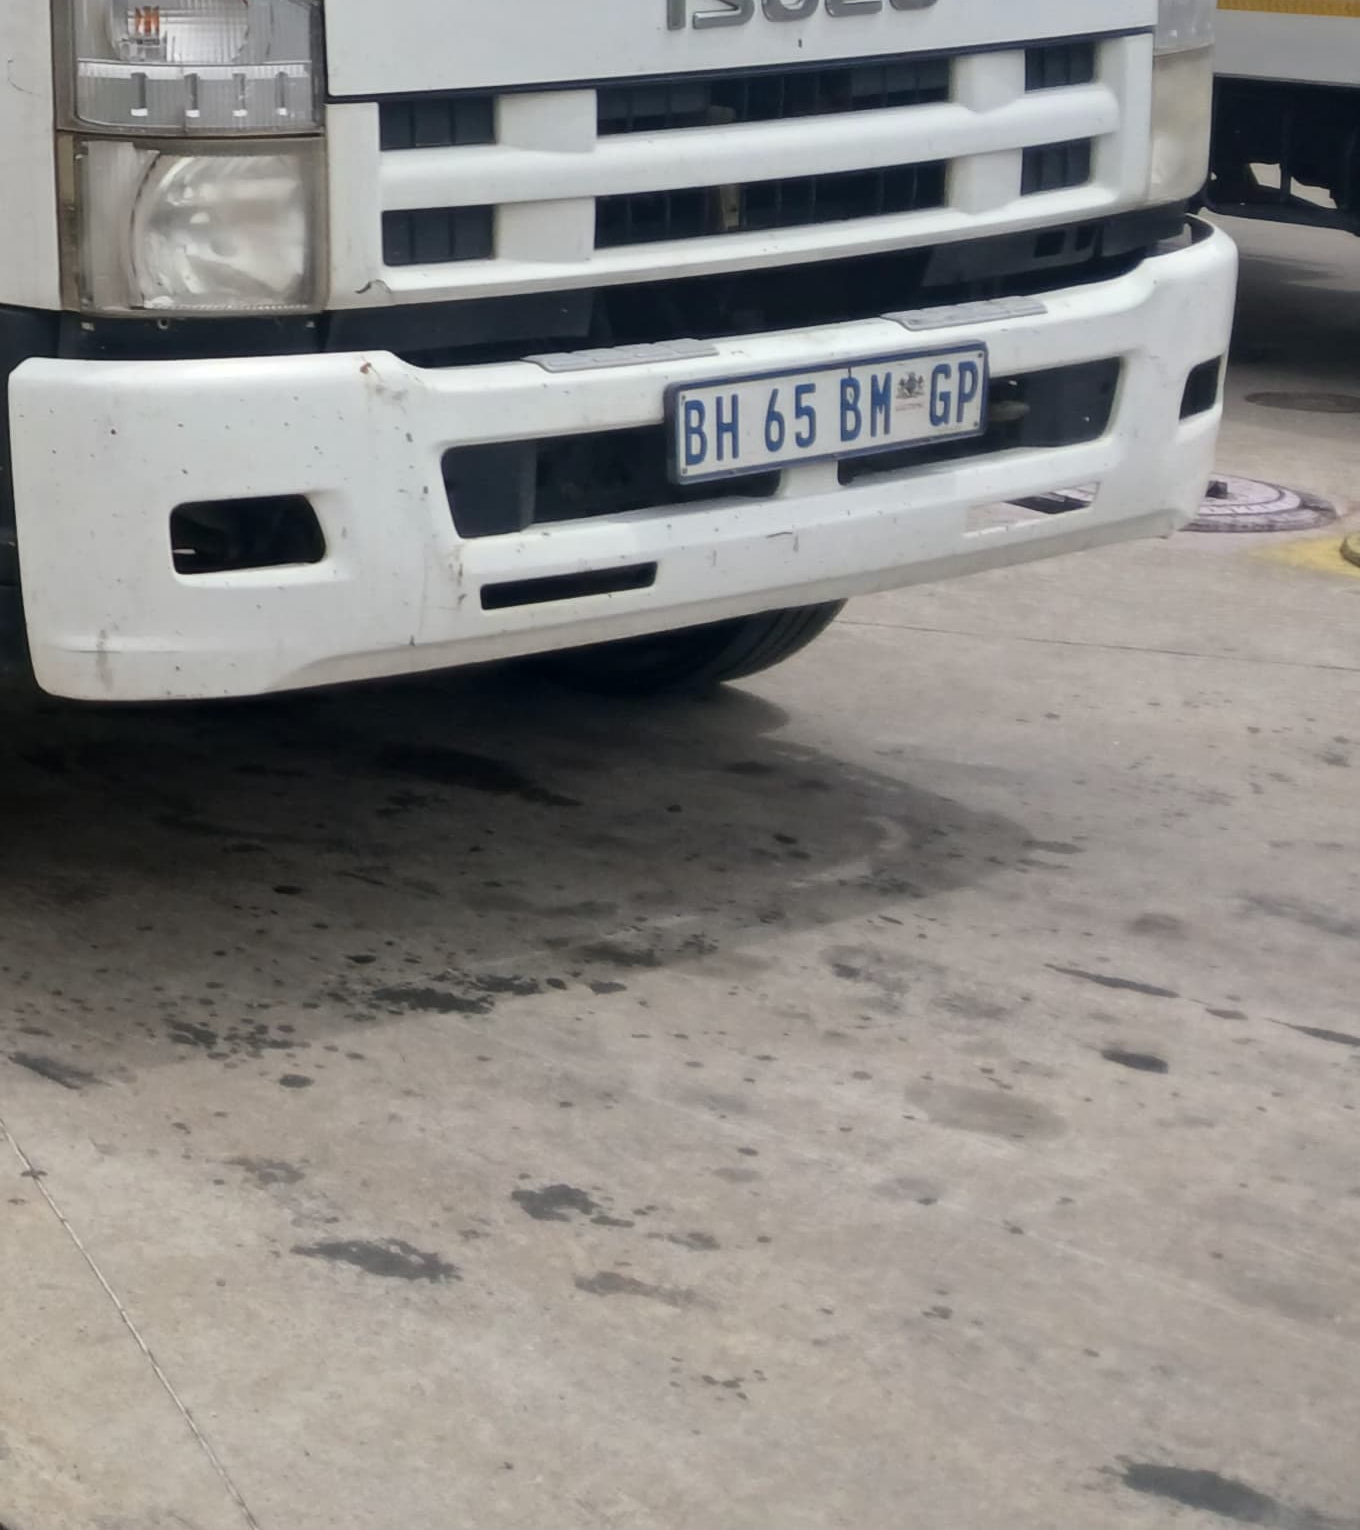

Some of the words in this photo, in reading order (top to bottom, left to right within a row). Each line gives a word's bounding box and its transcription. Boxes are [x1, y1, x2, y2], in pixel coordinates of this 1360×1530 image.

[684, 394, 740, 467] BH
[764, 383, 817, 453] 65
[839, 372, 892, 443] BM
[929, 360, 979, 427] GP
